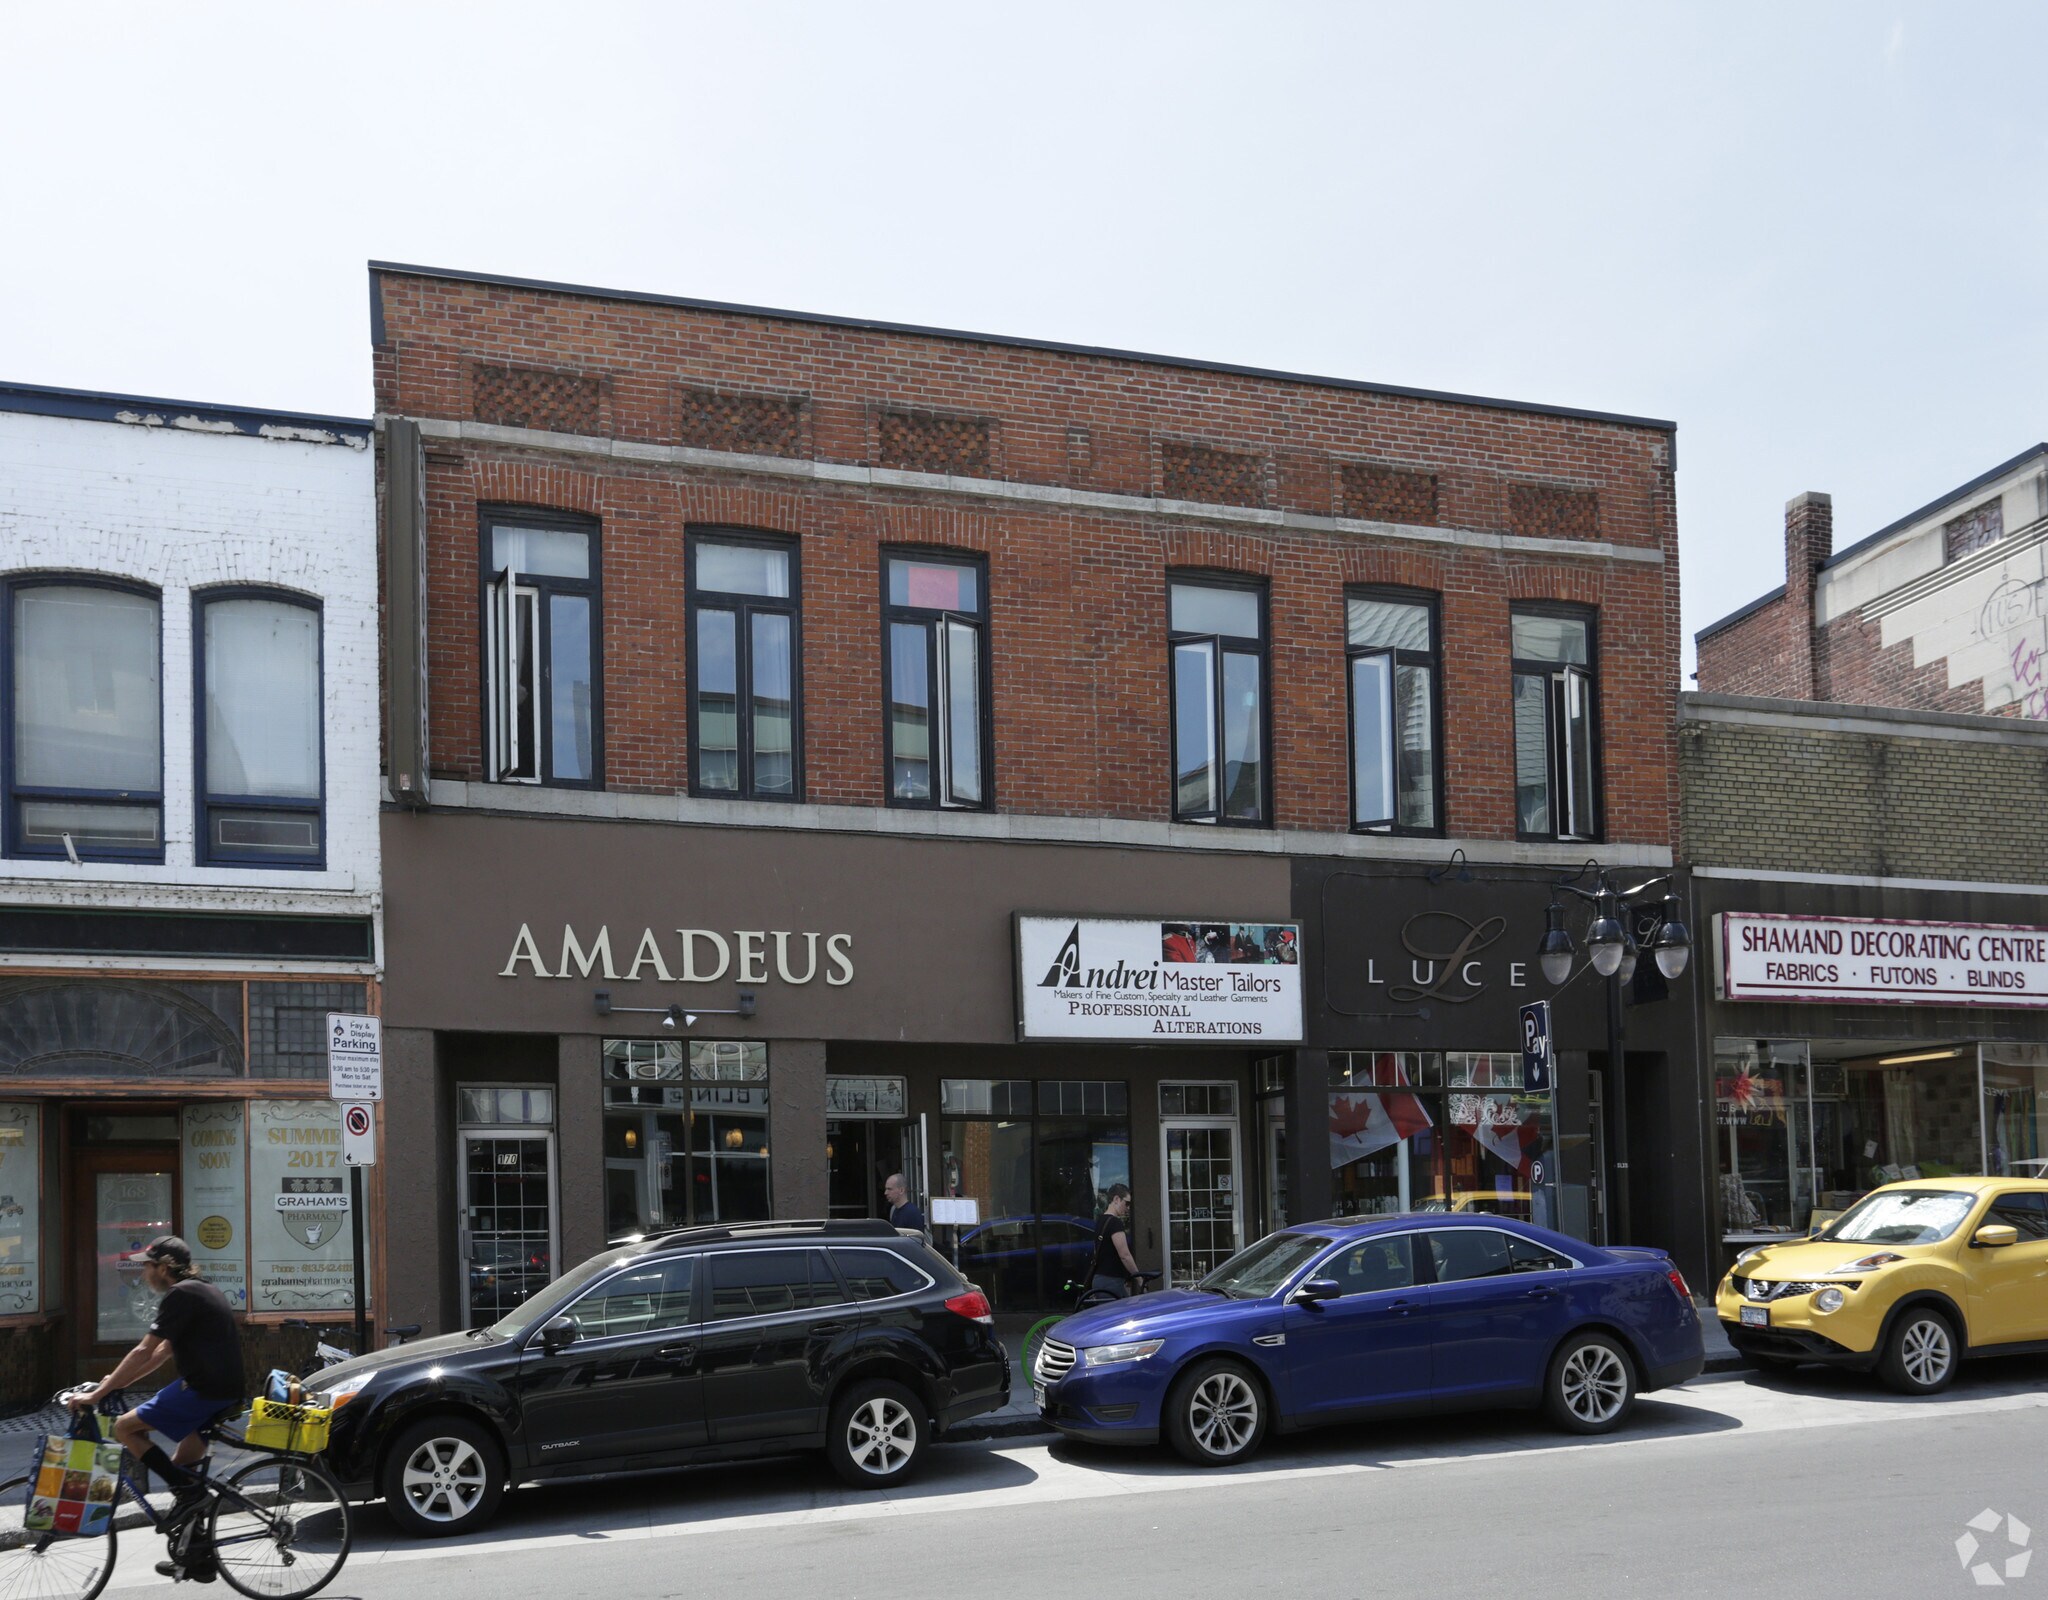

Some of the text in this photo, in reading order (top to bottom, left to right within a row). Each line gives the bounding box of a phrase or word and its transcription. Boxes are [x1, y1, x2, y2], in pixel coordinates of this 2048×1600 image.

[1742, 925, 2046, 963] SHAMAND DECORATING CENTRE
[498, 923, 854, 986] AMADEUS
[1037, 920, 1281, 992] Andrei Master Tailors
[1368, 959, 1526, 987] LUCE
[1766, 962, 2025, 989] FABRICS FUTONS BLINDS
[1053, 989, 1083, 999] Makers
[1085, 991, 1094, 999] of
[1096, 991, 1111, 999] Fine
[1148, 992, 1181, 1003] Specialty
[1184, 993, 1198, 1002] and
[1200, 993, 1228, 1002] Leather
[1231, 993, 1268, 1003] Garments
[1068, 1001, 1191, 1017] PROFESSIONAL
[350, 1030, 376, 1039] Display
[1153, 1019, 1262, 1035] ALTERATIONS
[333, 1037, 376, 1052] Parking
[1525, 1019, 1546, 1059] Pay
[191, 1129, 236, 1147] COMING
[267, 1127, 341, 1145] SUMME
[199, 1151, 231, 1169] SOON
[287, 1151, 340, 1168] 2017
[498, 1154, 518, 1164] 170
[277, 1197, 348, 1207] GRAHAM'S
[287, 1213, 339, 1221] PHARMACY
[261, 1276, 354, 1287] grahamspharmacy.c
[541, 1440, 580, 1450] OUTBACK
